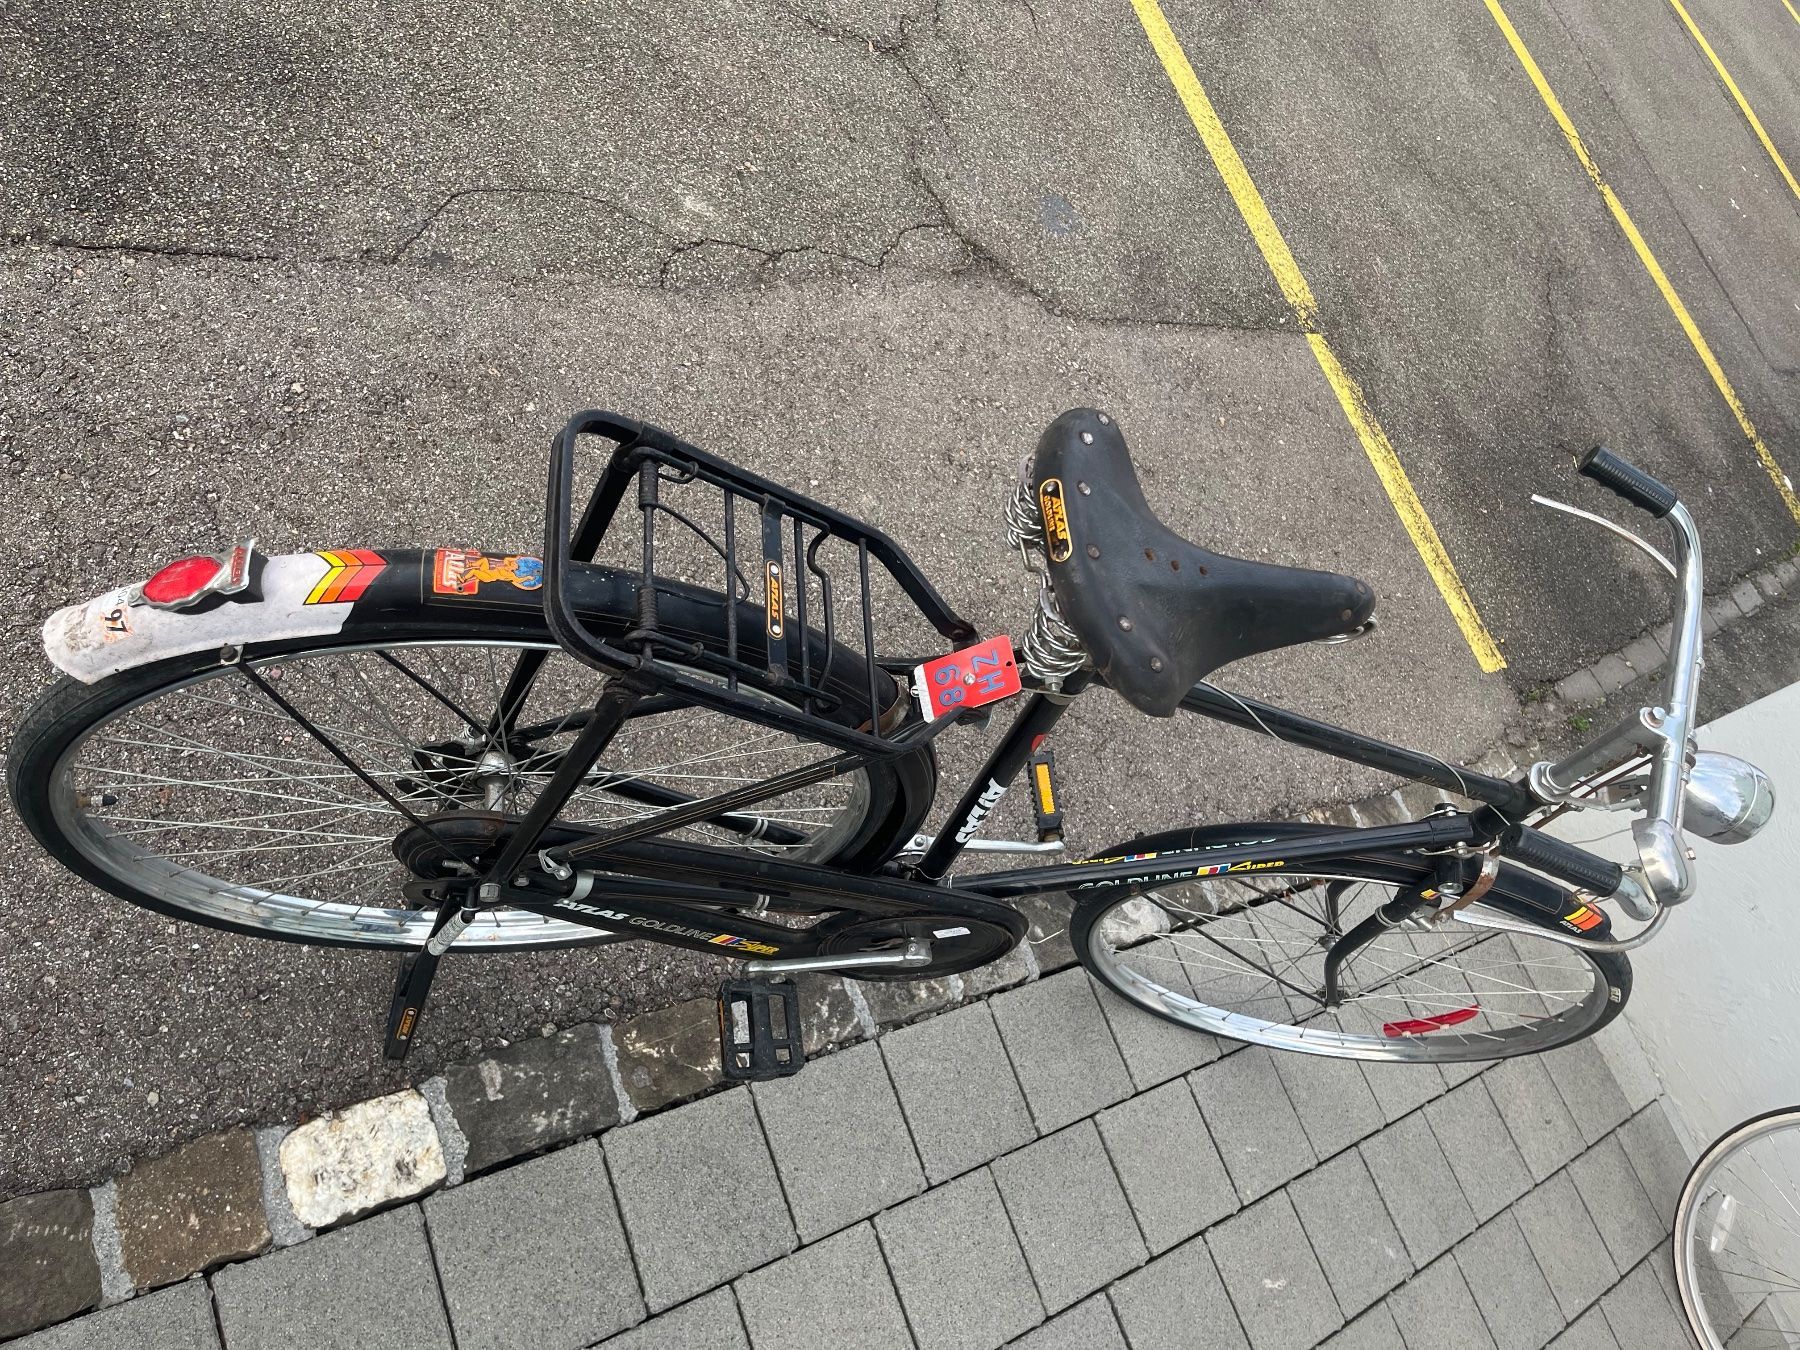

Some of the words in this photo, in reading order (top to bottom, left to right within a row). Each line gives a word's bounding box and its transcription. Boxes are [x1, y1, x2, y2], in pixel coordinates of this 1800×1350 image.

[1051, 496, 1068, 540] ATLAS
[769, 576, 780, 621] ATLAS
[104, 608, 129, 633] 97
[934, 664, 966, 706] 68
[971, 648, 1005, 695] ZH
[955, 777, 1008, 844] ATLAS
[553, 901, 631, 920] ATLAS
[629, 917, 717, 941] GOLDLINE
[1559, 920, 1584, 934] ATLAS
